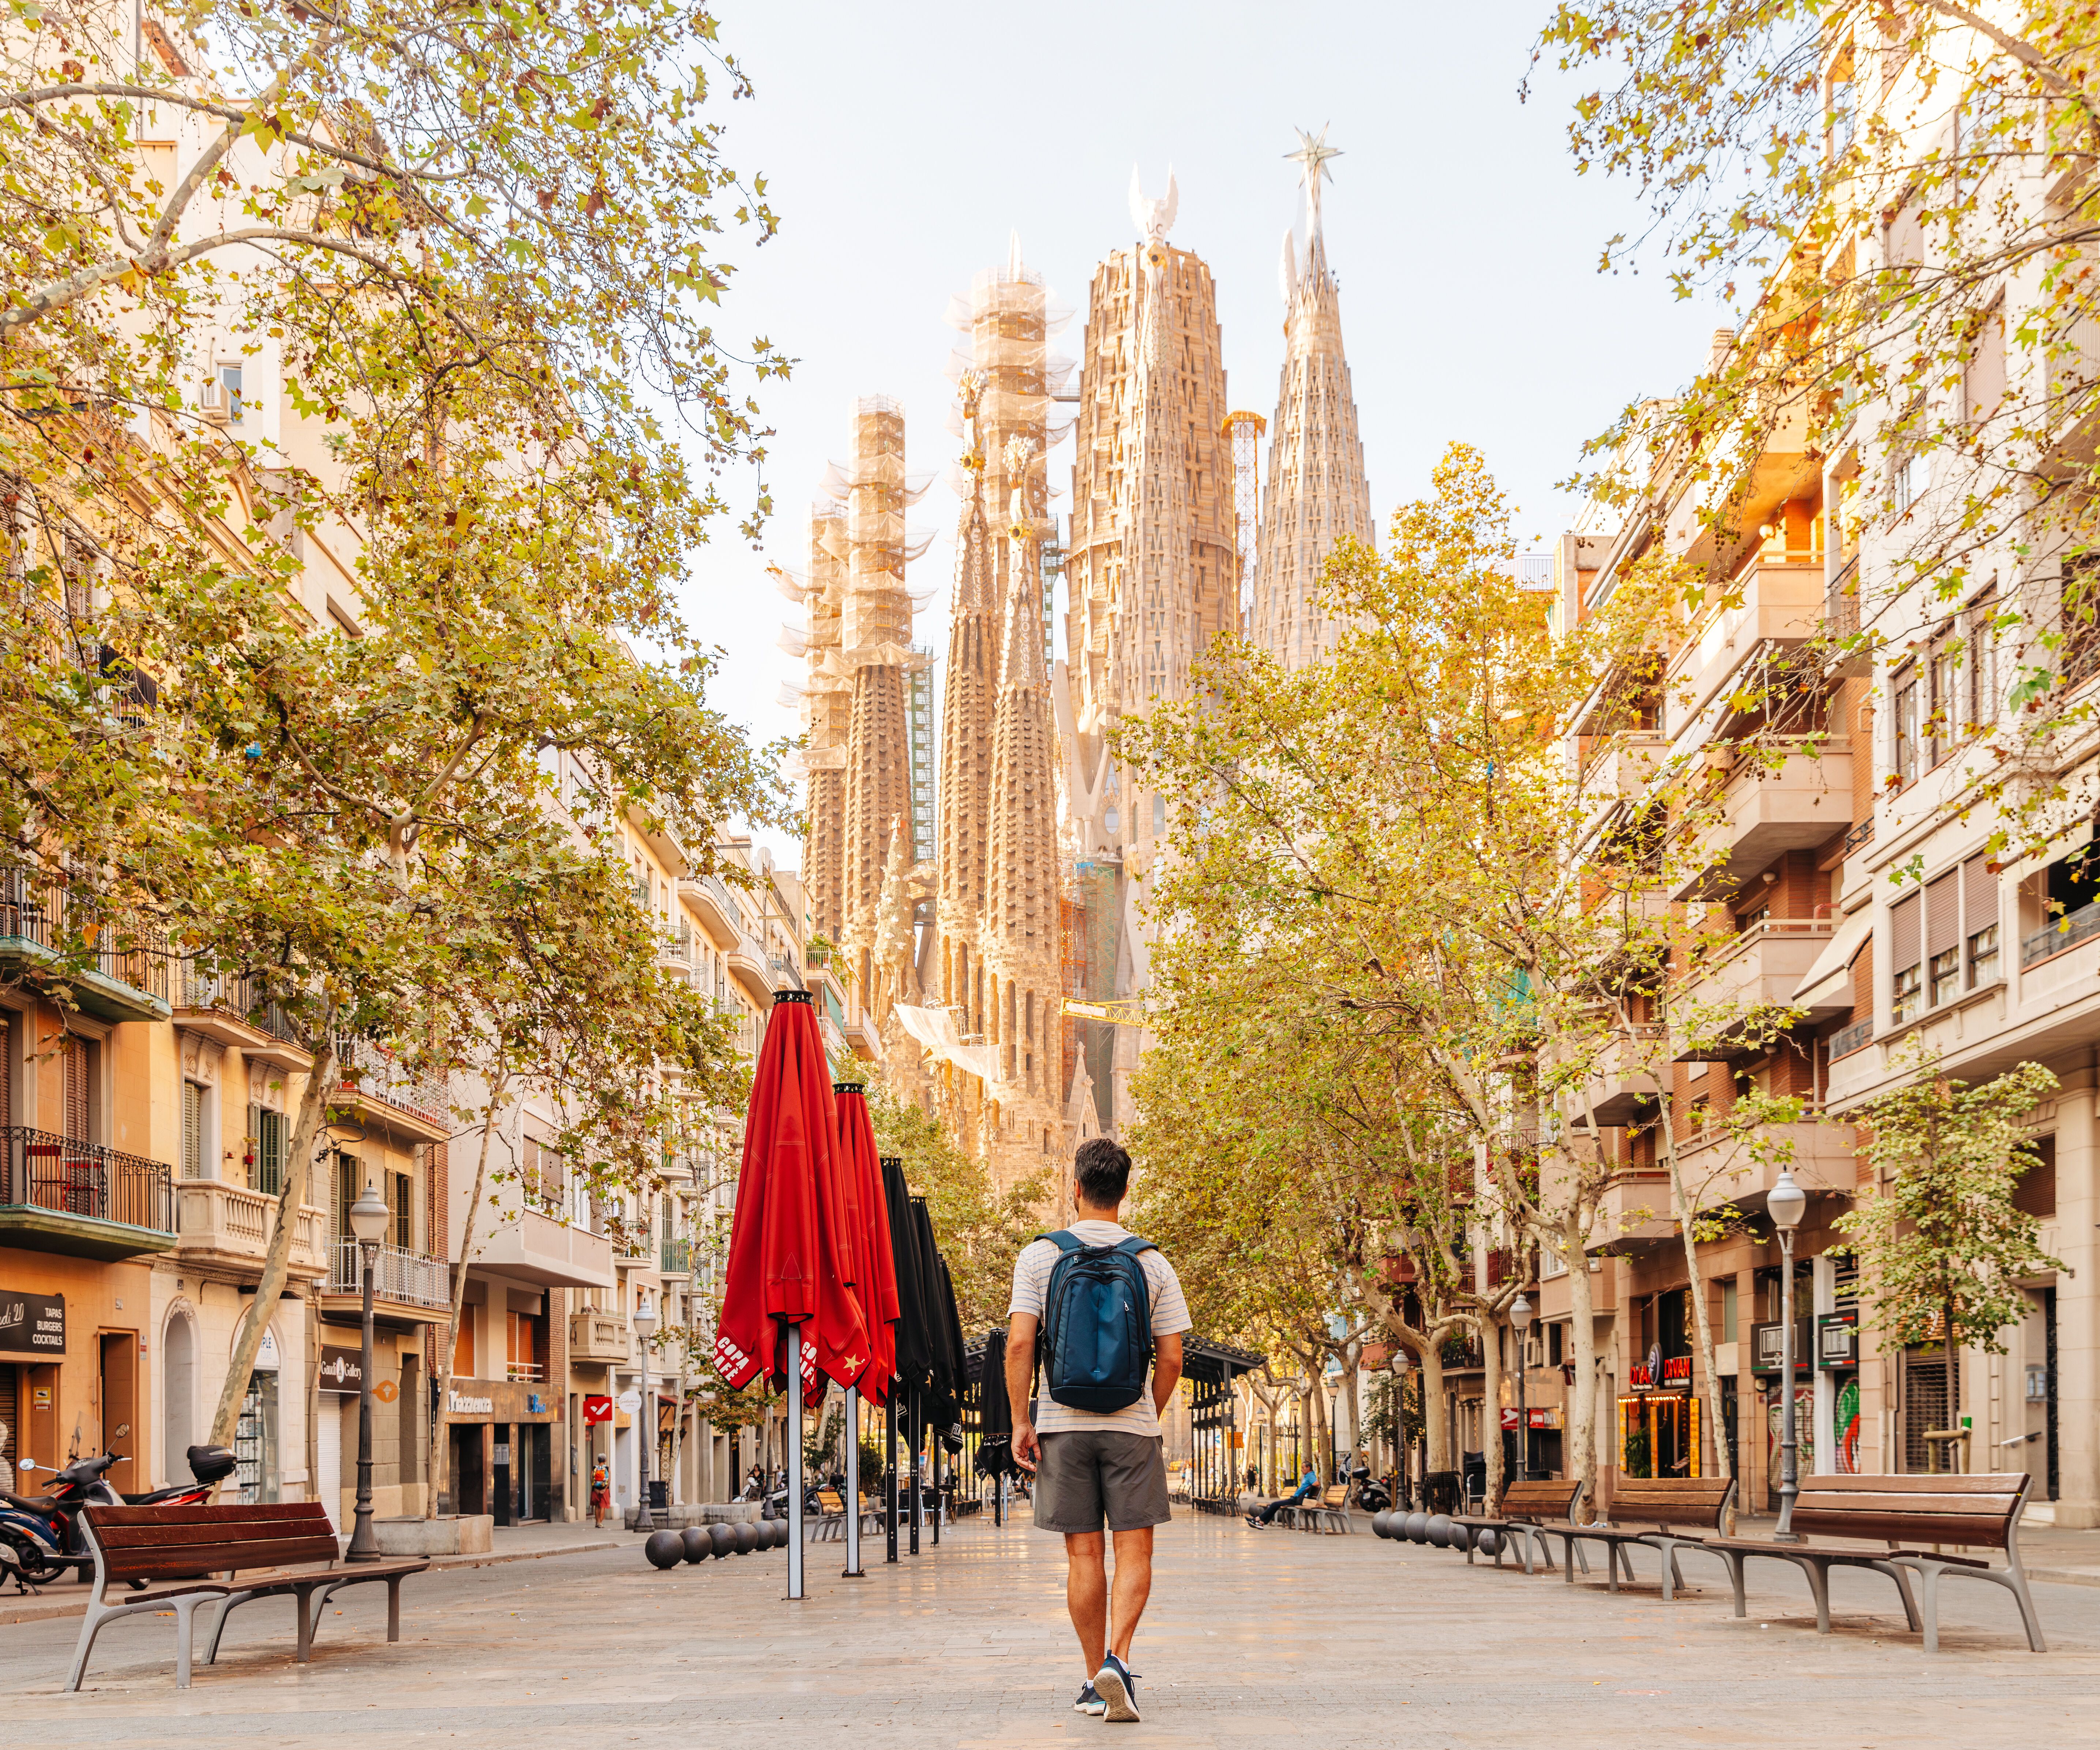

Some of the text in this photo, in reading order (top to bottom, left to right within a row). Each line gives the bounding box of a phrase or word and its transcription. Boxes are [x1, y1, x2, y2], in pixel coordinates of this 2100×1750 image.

[14, 1303, 24, 1322] 20
[45, 1307, 62, 1319] TAPAS
[37, 1320, 63, 1332] BURGERS
[32, 1334, 63, 1346] COCKTAILS
[717, 1337, 749, 1370] COPA
[345, 1363, 361, 1380] Gallery
